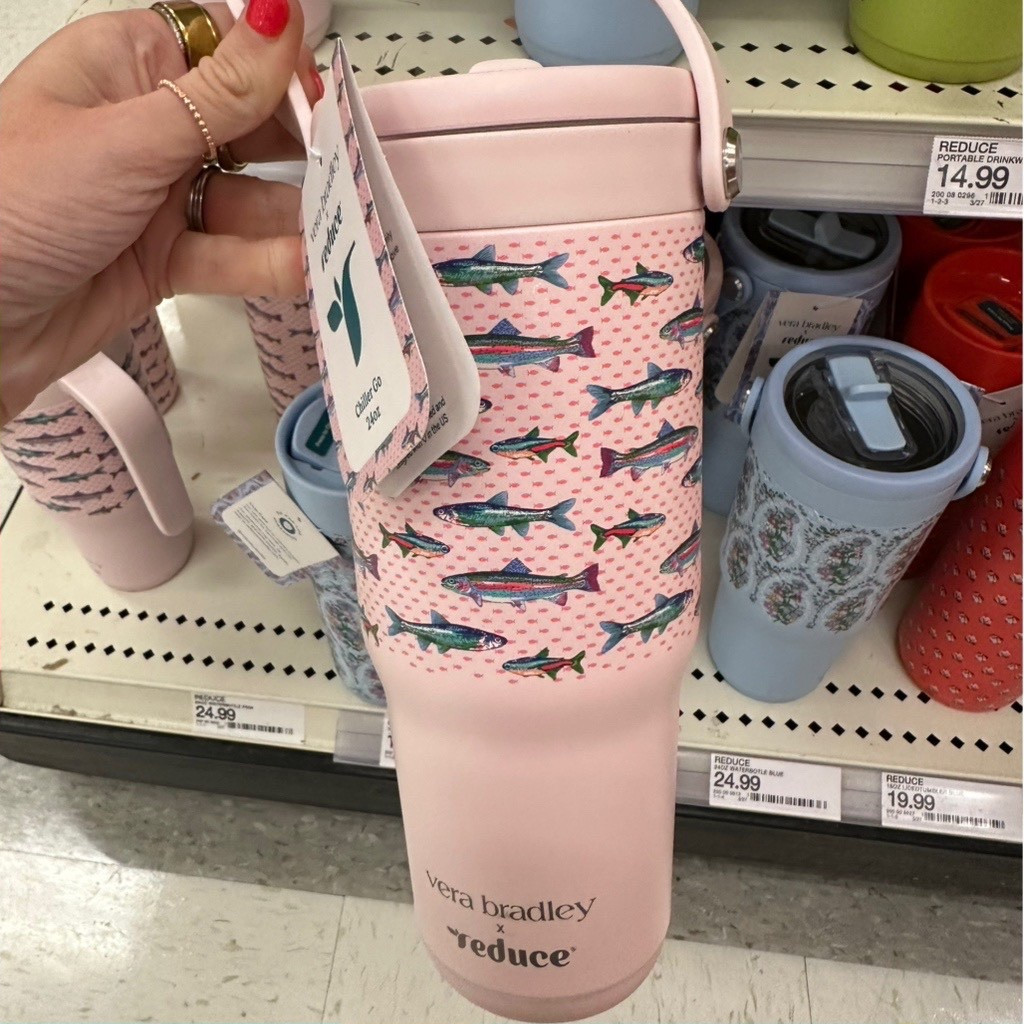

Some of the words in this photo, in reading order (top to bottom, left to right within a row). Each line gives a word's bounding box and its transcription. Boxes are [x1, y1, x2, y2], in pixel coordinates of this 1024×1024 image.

[939, 140, 999, 154] REDUCE
[937, 154, 985, 163] PORTABLE
[937, 164, 1010, 190] 14.99
[321, 203, 343, 272] reduce
[355, 388, 374, 418] Chiller
[372, 376, 383, 392] Go
[366, 406, 381, 430] 24oz
[439, 413, 449, 427] US
[196, 705, 236, 721] 24.99
[714, 756, 751, 767] REDUCE
[713, 771, 761, 791] 24.99
[886, 774, 924, 786] REDUCE
[887, 790, 935, 811] 19.99
[426, 870, 474, 910] vera
[481, 895, 596, 922] bradley
[496, 923, 505, 933] x
[451, 929, 573, 968] reduce
